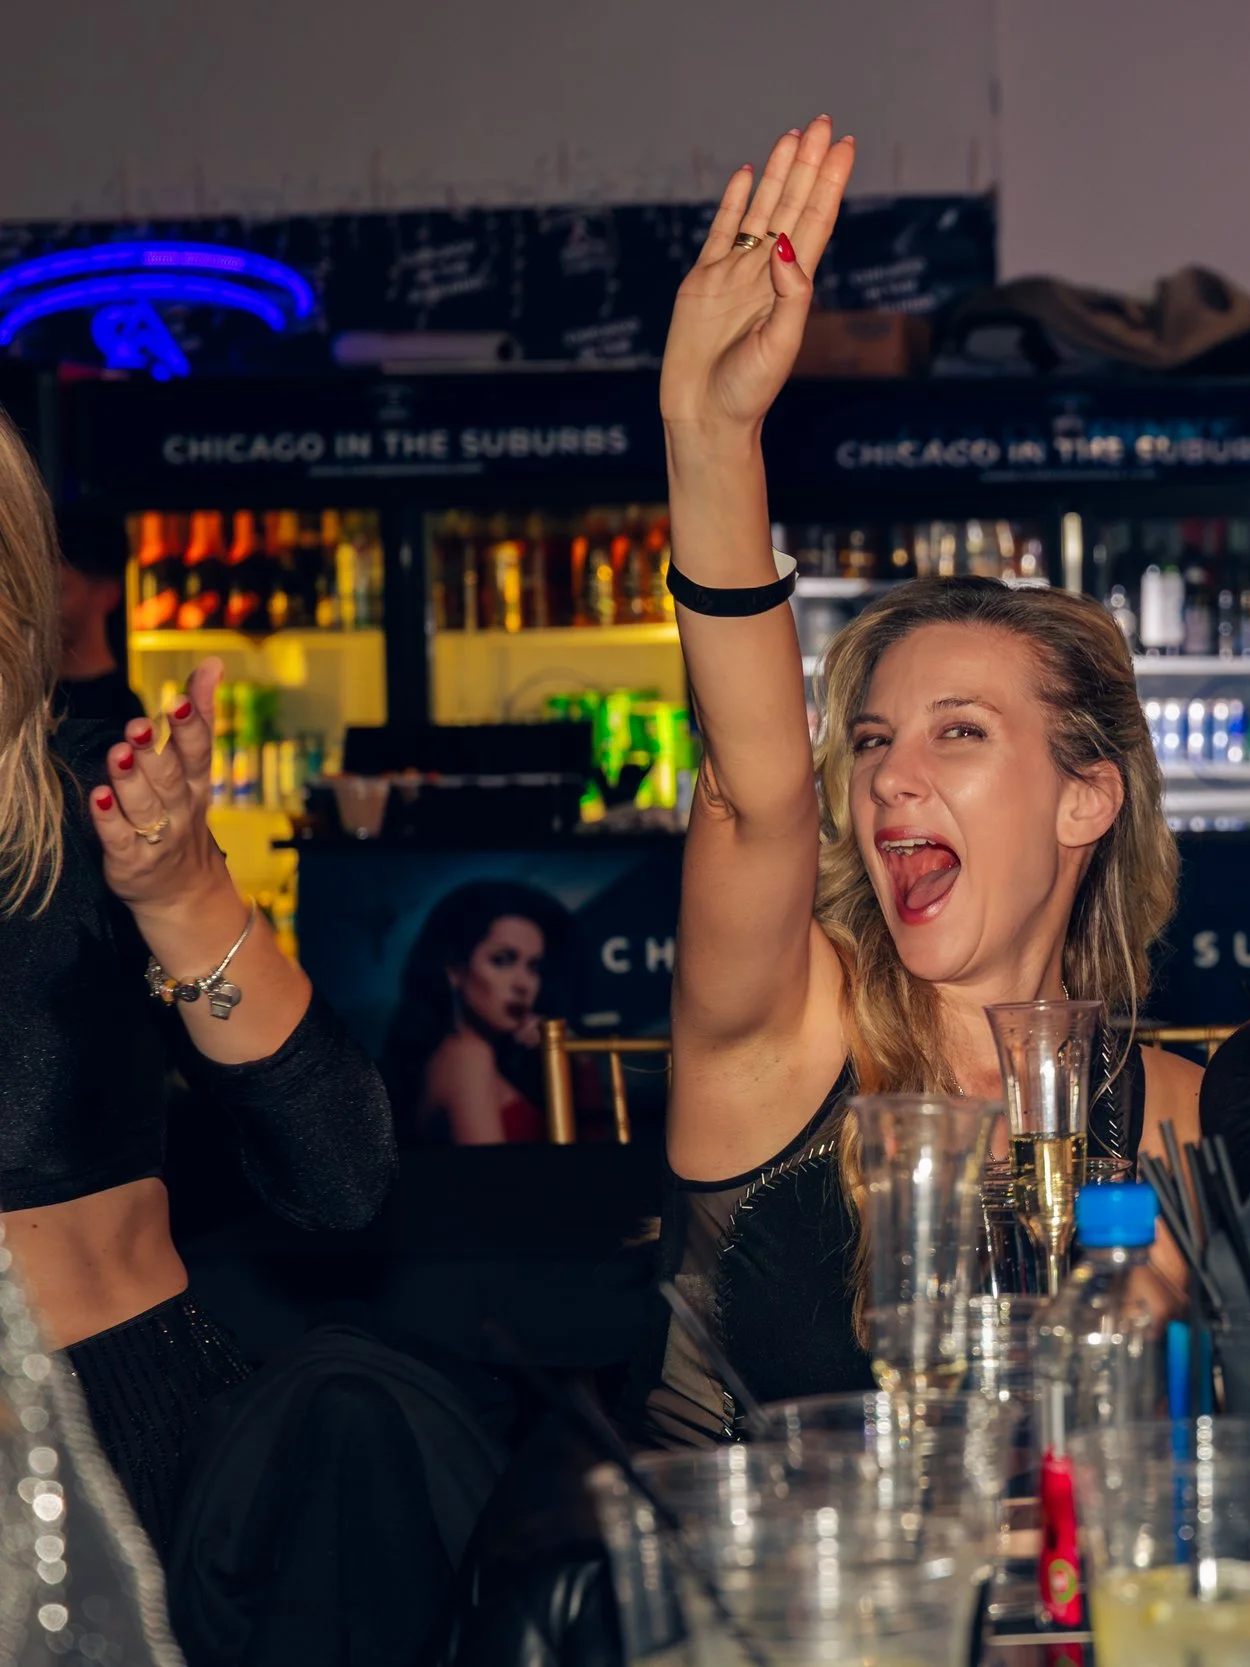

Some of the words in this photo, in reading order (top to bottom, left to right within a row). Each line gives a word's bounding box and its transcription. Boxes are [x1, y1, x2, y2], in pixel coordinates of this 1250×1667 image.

[163, 433, 325, 465] CHICAGO
[334, 434, 371, 460] IN
[384, 430, 449, 460] THE
[460, 426, 628, 459] SUBURBS
[836, 438, 1000, 469] CHICAGO
[1008, 440, 1047, 466] IN
[1054, 436, 1124, 465] THE
[601, 935, 674, 974] CH
